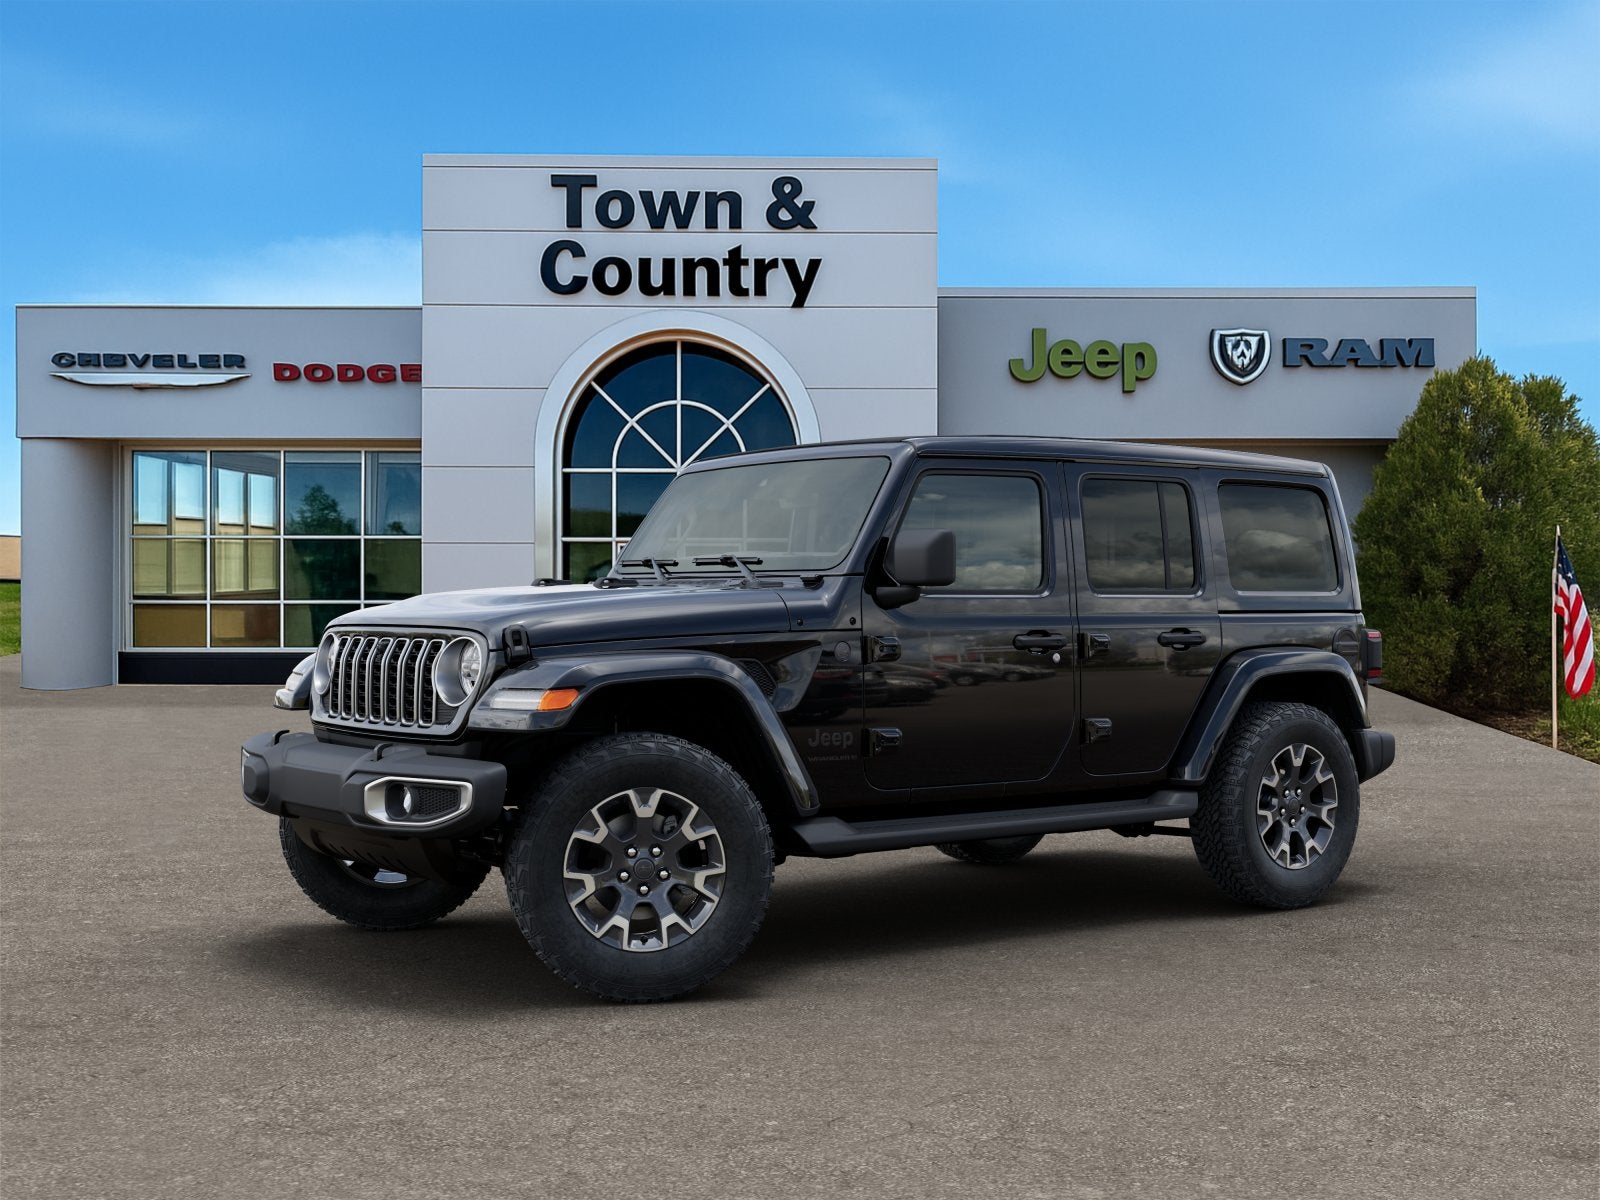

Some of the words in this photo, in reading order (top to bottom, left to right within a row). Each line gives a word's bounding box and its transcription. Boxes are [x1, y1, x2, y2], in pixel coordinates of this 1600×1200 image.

[550, 174, 742, 229] Town
[765, 176, 818, 230] &
[540, 239, 822, 308] Country
[273, 362, 422, 383] DODGE
[1008, 327, 1158, 393] Jeep
[1282, 338, 1436, 368] RAM
[807, 728, 854, 749] Jeep
